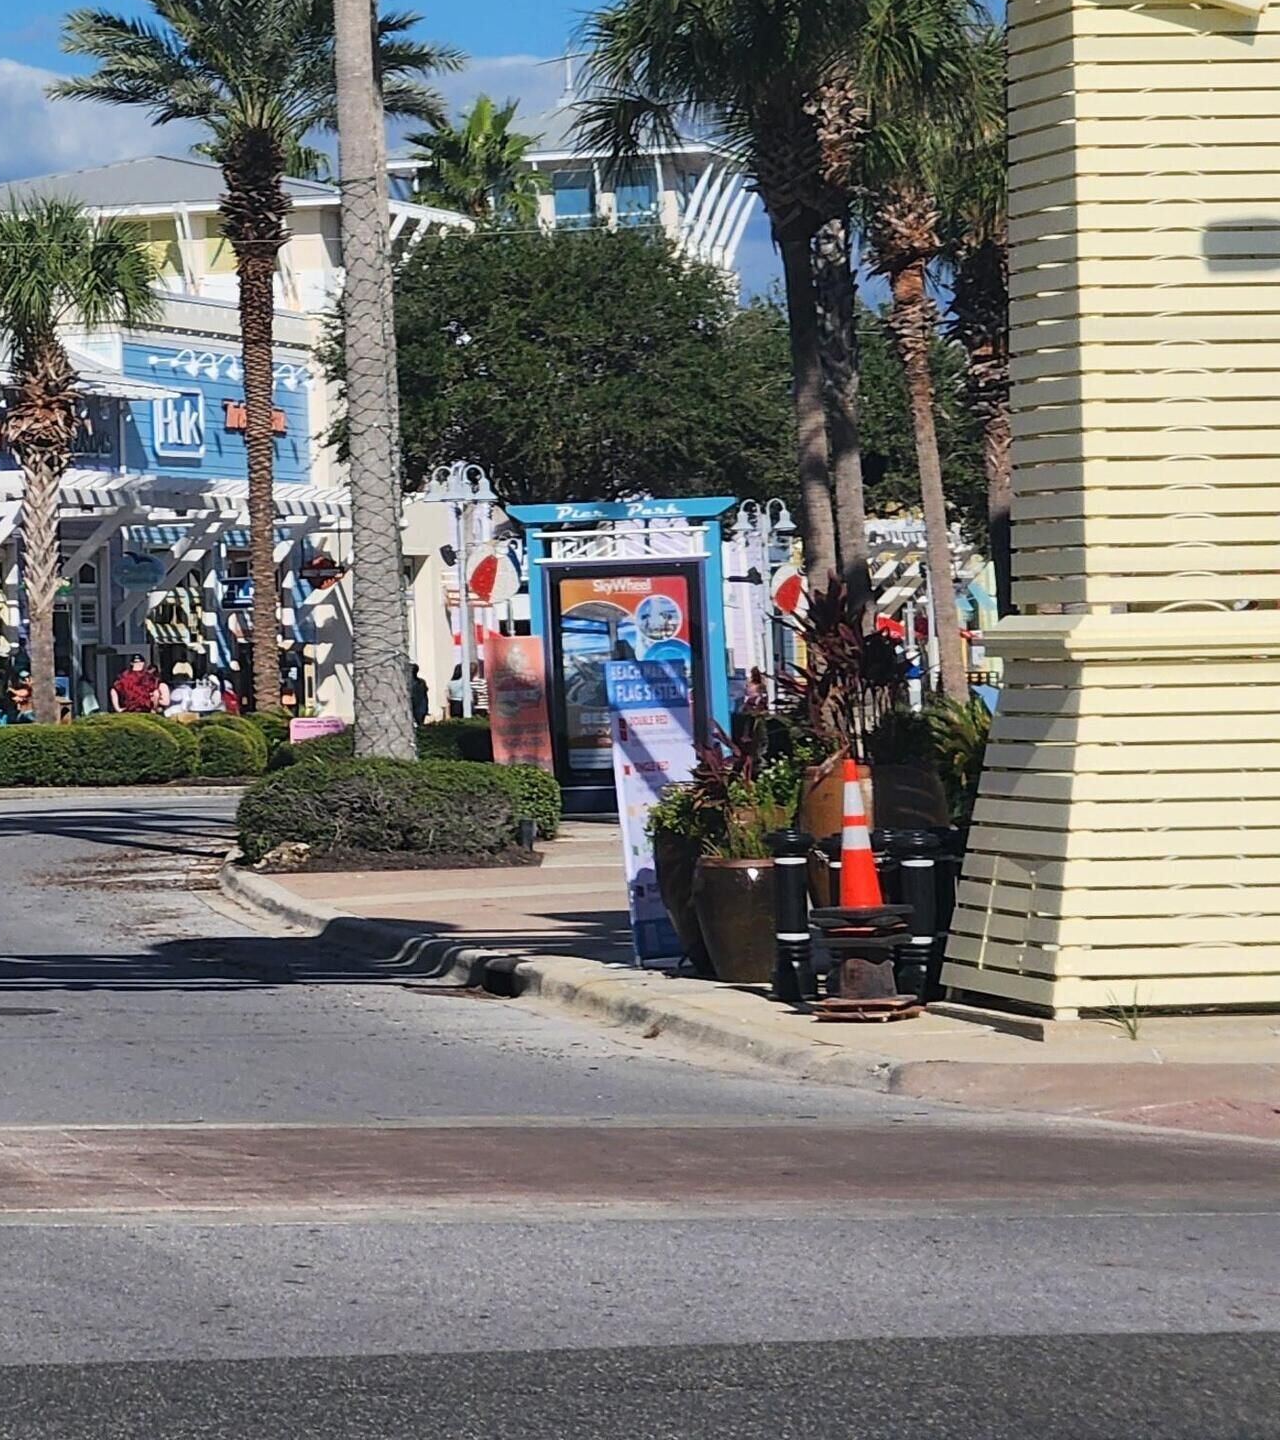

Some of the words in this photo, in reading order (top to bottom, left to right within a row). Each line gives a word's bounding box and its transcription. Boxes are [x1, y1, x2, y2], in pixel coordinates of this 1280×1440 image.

[556, 505, 608, 520] Pier
[625, 502, 684, 517] Park
[592, 578, 652, 595] SkyWheel
[616, 684, 643, 702] FLAG
